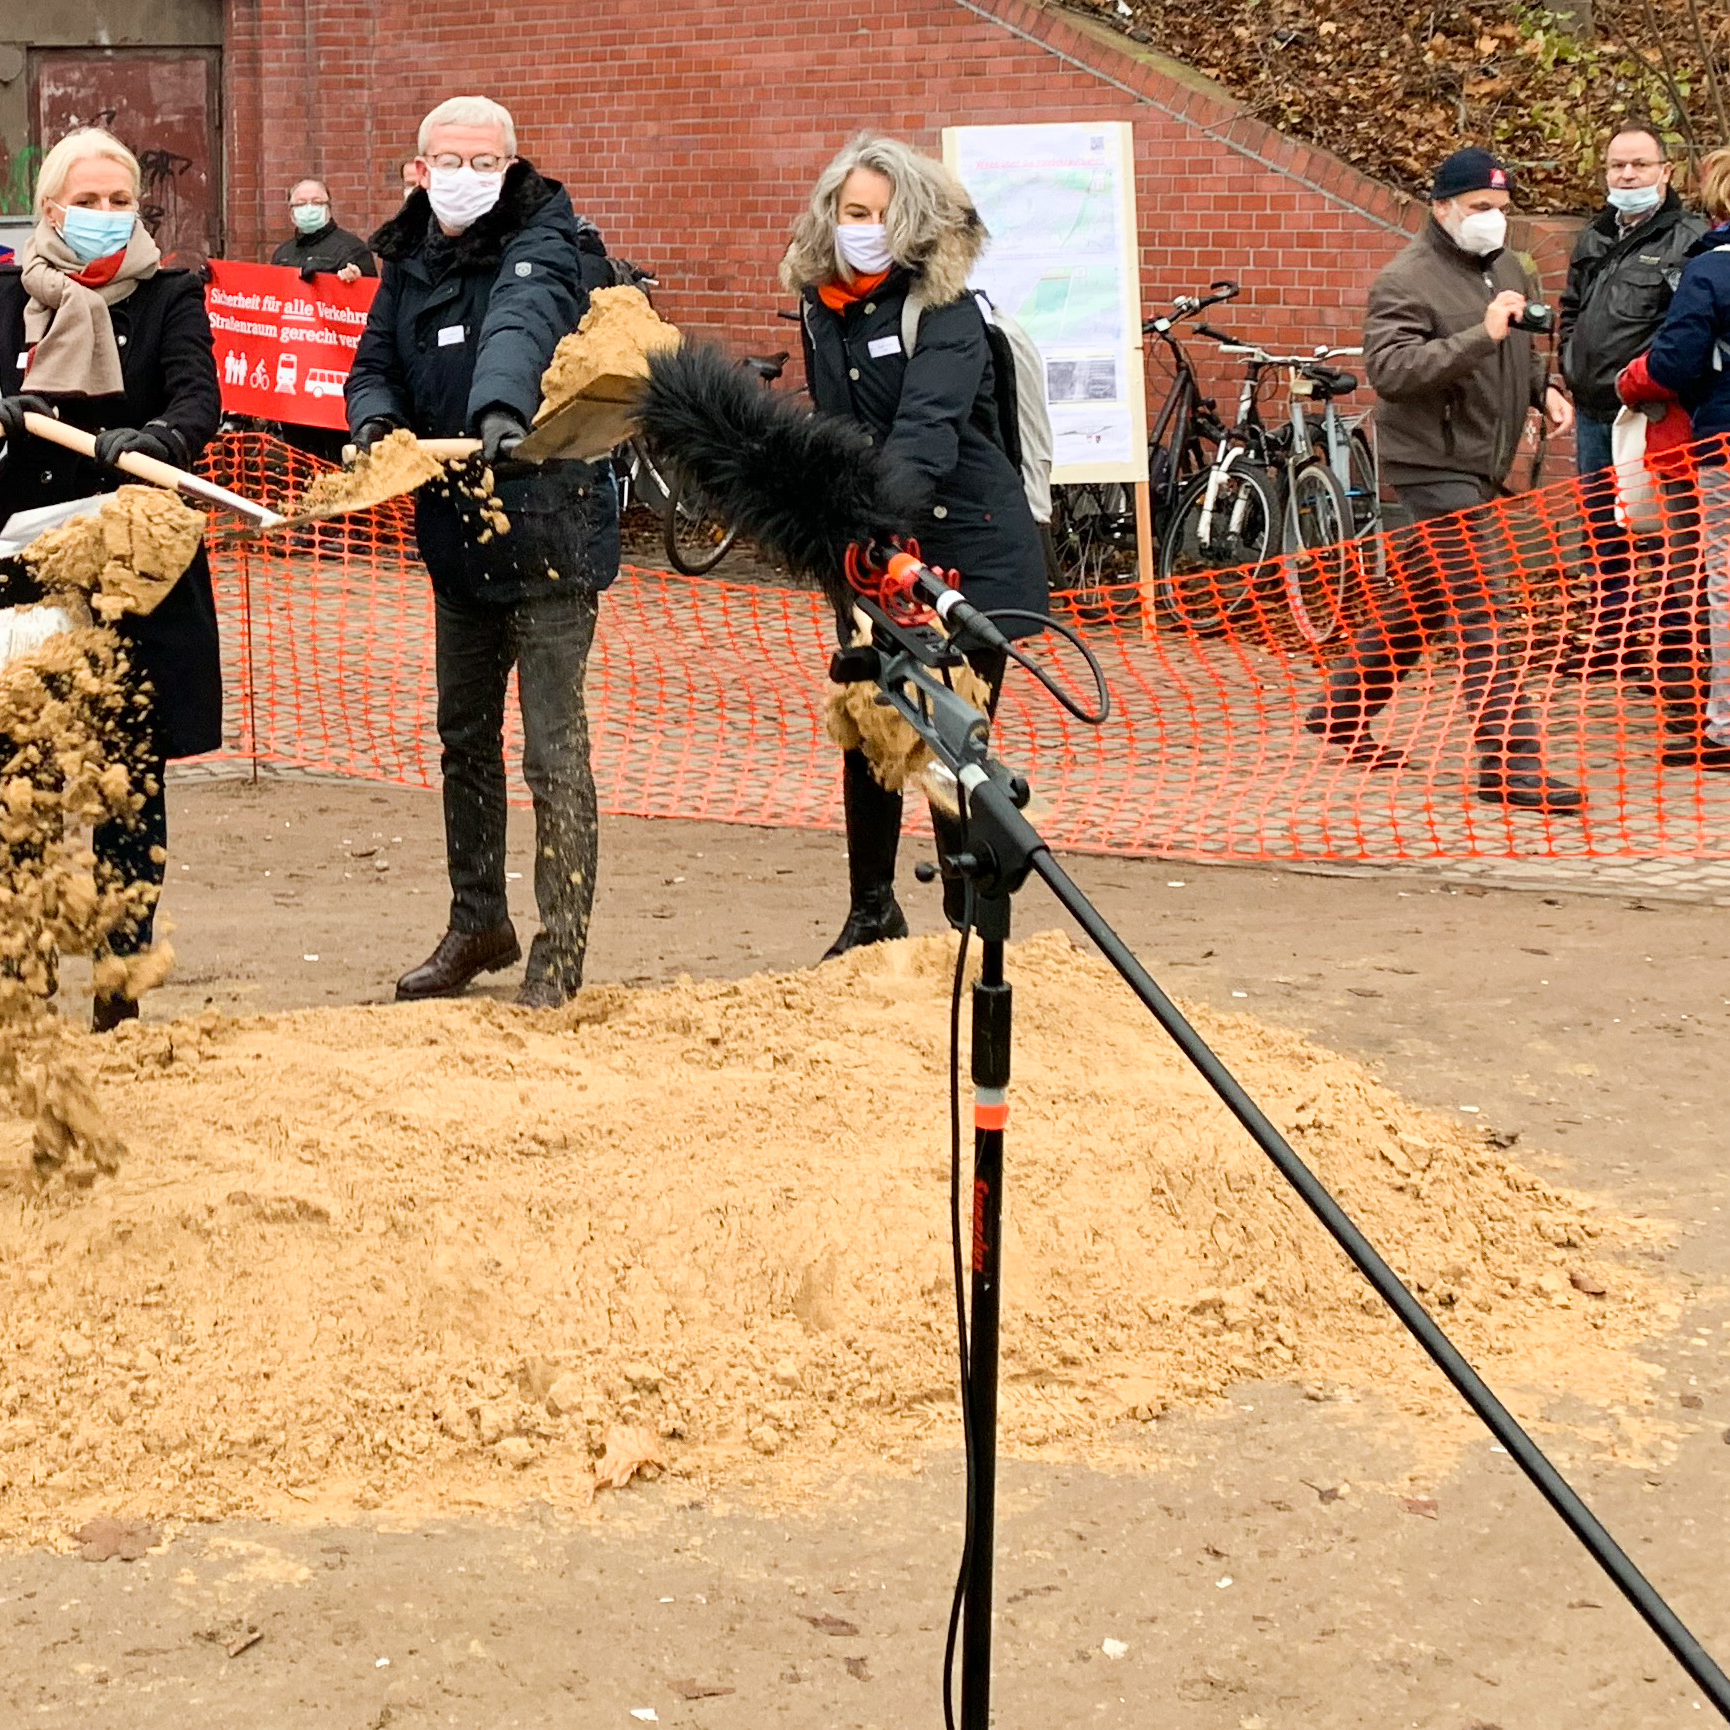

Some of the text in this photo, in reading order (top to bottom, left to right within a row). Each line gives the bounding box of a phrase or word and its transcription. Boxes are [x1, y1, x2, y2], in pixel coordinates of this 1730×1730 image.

[210, 287, 261, 310] Sicherheit
[261, 295, 282, 313] für
[284, 299, 314, 317] alle
[208, 312, 362, 349] Straßenraum gerecht ver
